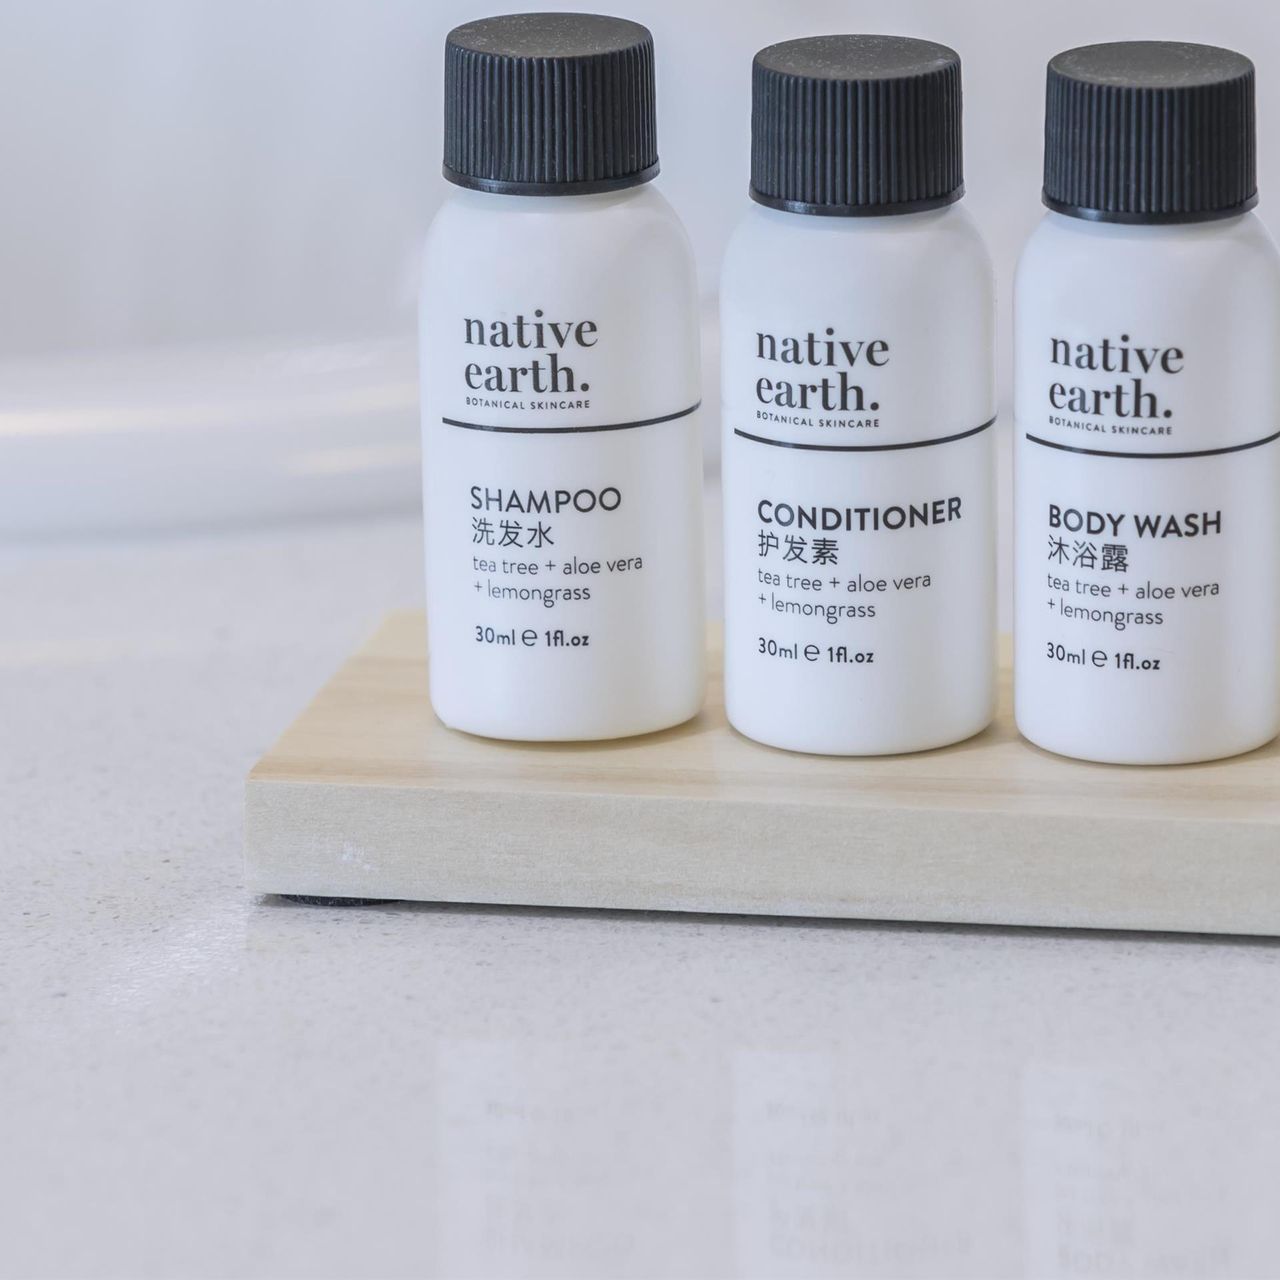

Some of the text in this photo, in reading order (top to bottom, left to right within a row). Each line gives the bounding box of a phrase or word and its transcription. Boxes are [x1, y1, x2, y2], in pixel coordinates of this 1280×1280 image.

[464, 309, 598, 349] native
[756, 327, 890, 367] native
[1050, 334, 1184, 374] native
[464, 353, 590, 393] earth.
[466, 396, 590, 410] BOTANICAL SKINCARE
[756, 371, 880, 411] earth.
[1049, 378, 1173, 419] earth.
[756, 411, 879, 428] BOTANICAL SKINCARE
[1049, 416, 1172, 435] BOTANICAL SKINCARE
[470, 486, 621, 513] SHAMPOO
[757, 496, 962, 531] CONDITIONER
[472, 517, 555, 548] 洗发水
[1049, 504, 1221, 538] BODY WASH
[758, 530, 839, 565] 护发素
[1047, 534, 1129, 572] 沐浴露
[473, 556, 643, 575] tea tree + aloe vera
[758, 568, 931, 592] tea tree + aloe vera
[474, 579, 591, 608] + lemongrass
[1047, 574, 1220, 599] tea tree + aloe vera
[758, 592, 876, 624] + lemongrass
[1047, 598, 1164, 631] + lemongrass
[476, 626, 515, 646] 30ml
[545, 630, 589, 646] 1fl.oz
[758, 638, 797, 659] 30ml
[827, 646, 874, 663] 1fl.oz
[1046, 643, 1085, 665] 30ml
[1115, 653, 1161, 670] 1fl.oz
